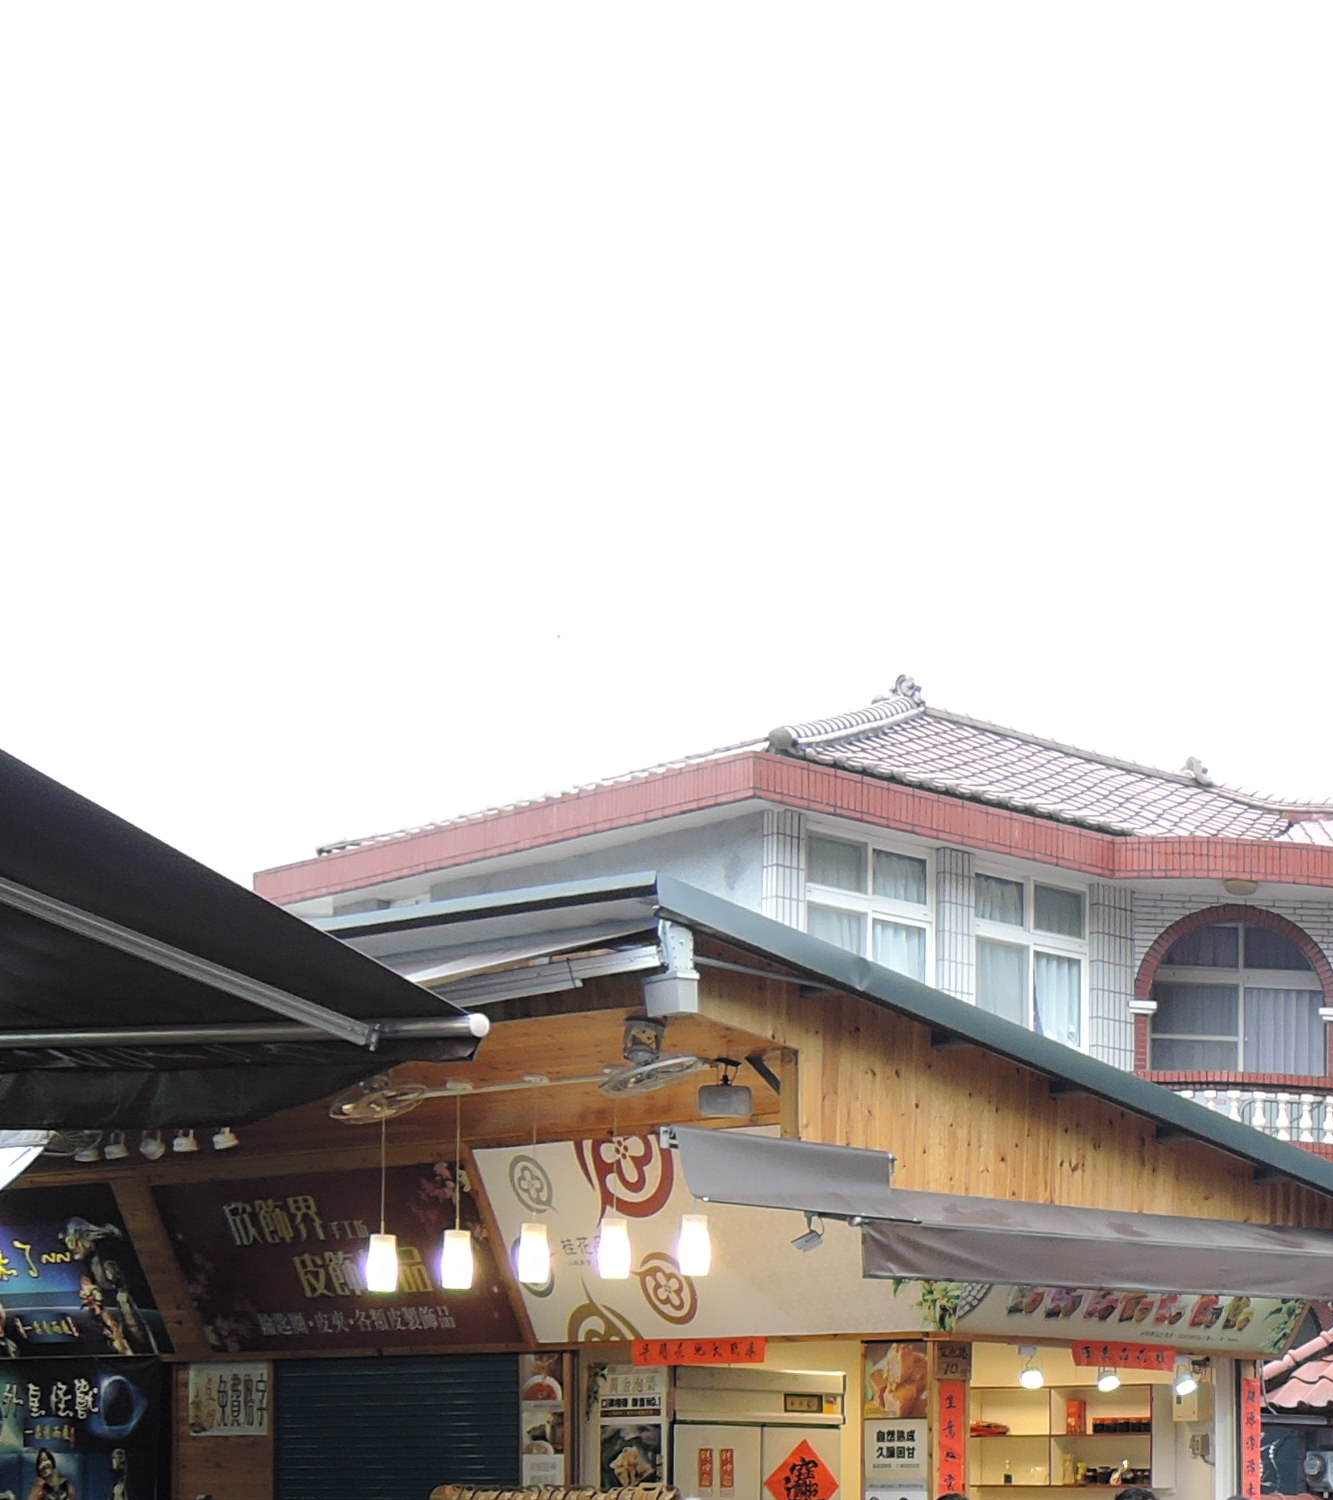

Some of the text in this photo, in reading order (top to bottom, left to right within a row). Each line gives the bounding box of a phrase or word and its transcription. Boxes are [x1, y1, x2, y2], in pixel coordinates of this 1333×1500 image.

[560, 1236, 604, 1256] 桂花
[293, 1245, 434, 1297] 皮飾品
